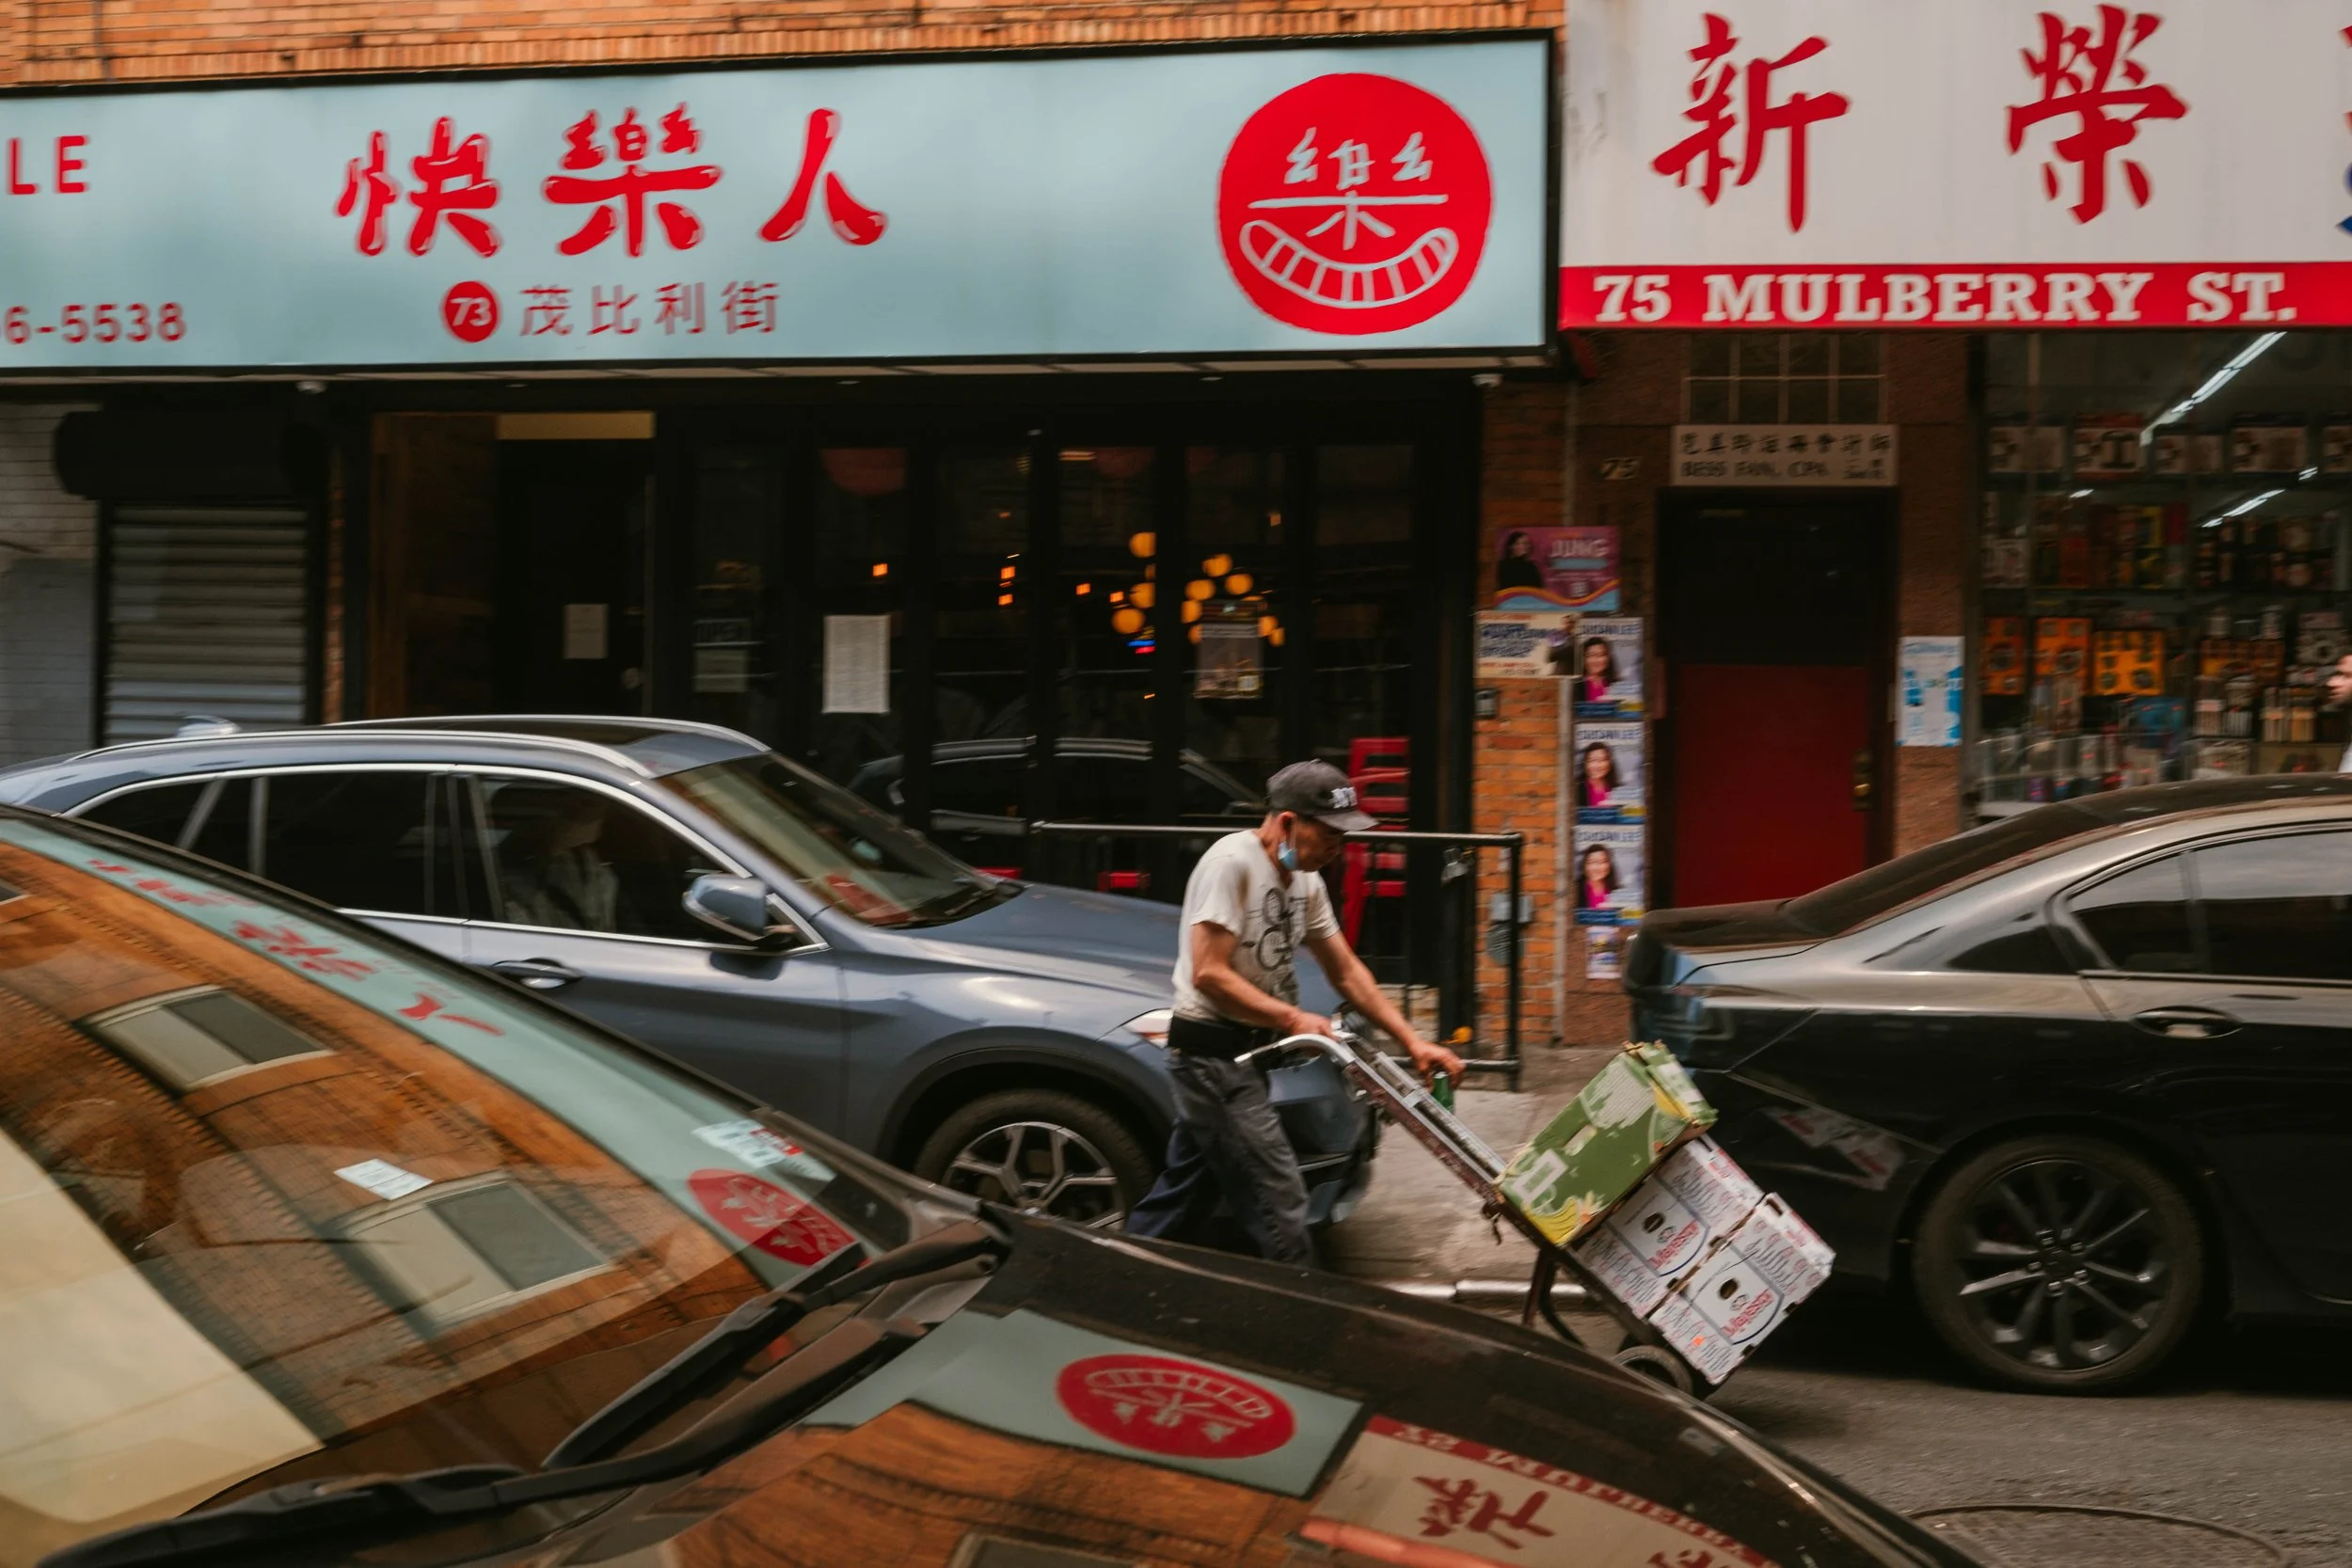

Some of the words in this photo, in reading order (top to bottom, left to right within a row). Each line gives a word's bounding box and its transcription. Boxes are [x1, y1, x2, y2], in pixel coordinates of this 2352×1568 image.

[1650, 3, 2189, 233] 新榮
[7, 135, 89, 195] LE
[335, 103, 888, 258] 快樂人
[450, 296, 493, 326] 73
[519, 281, 779, 335] 茂比利街
[1593, 274, 1671, 322] 75
[1702, 272, 2153, 322] MULBERRY
[2185, 271, 2297, 322] ST.
